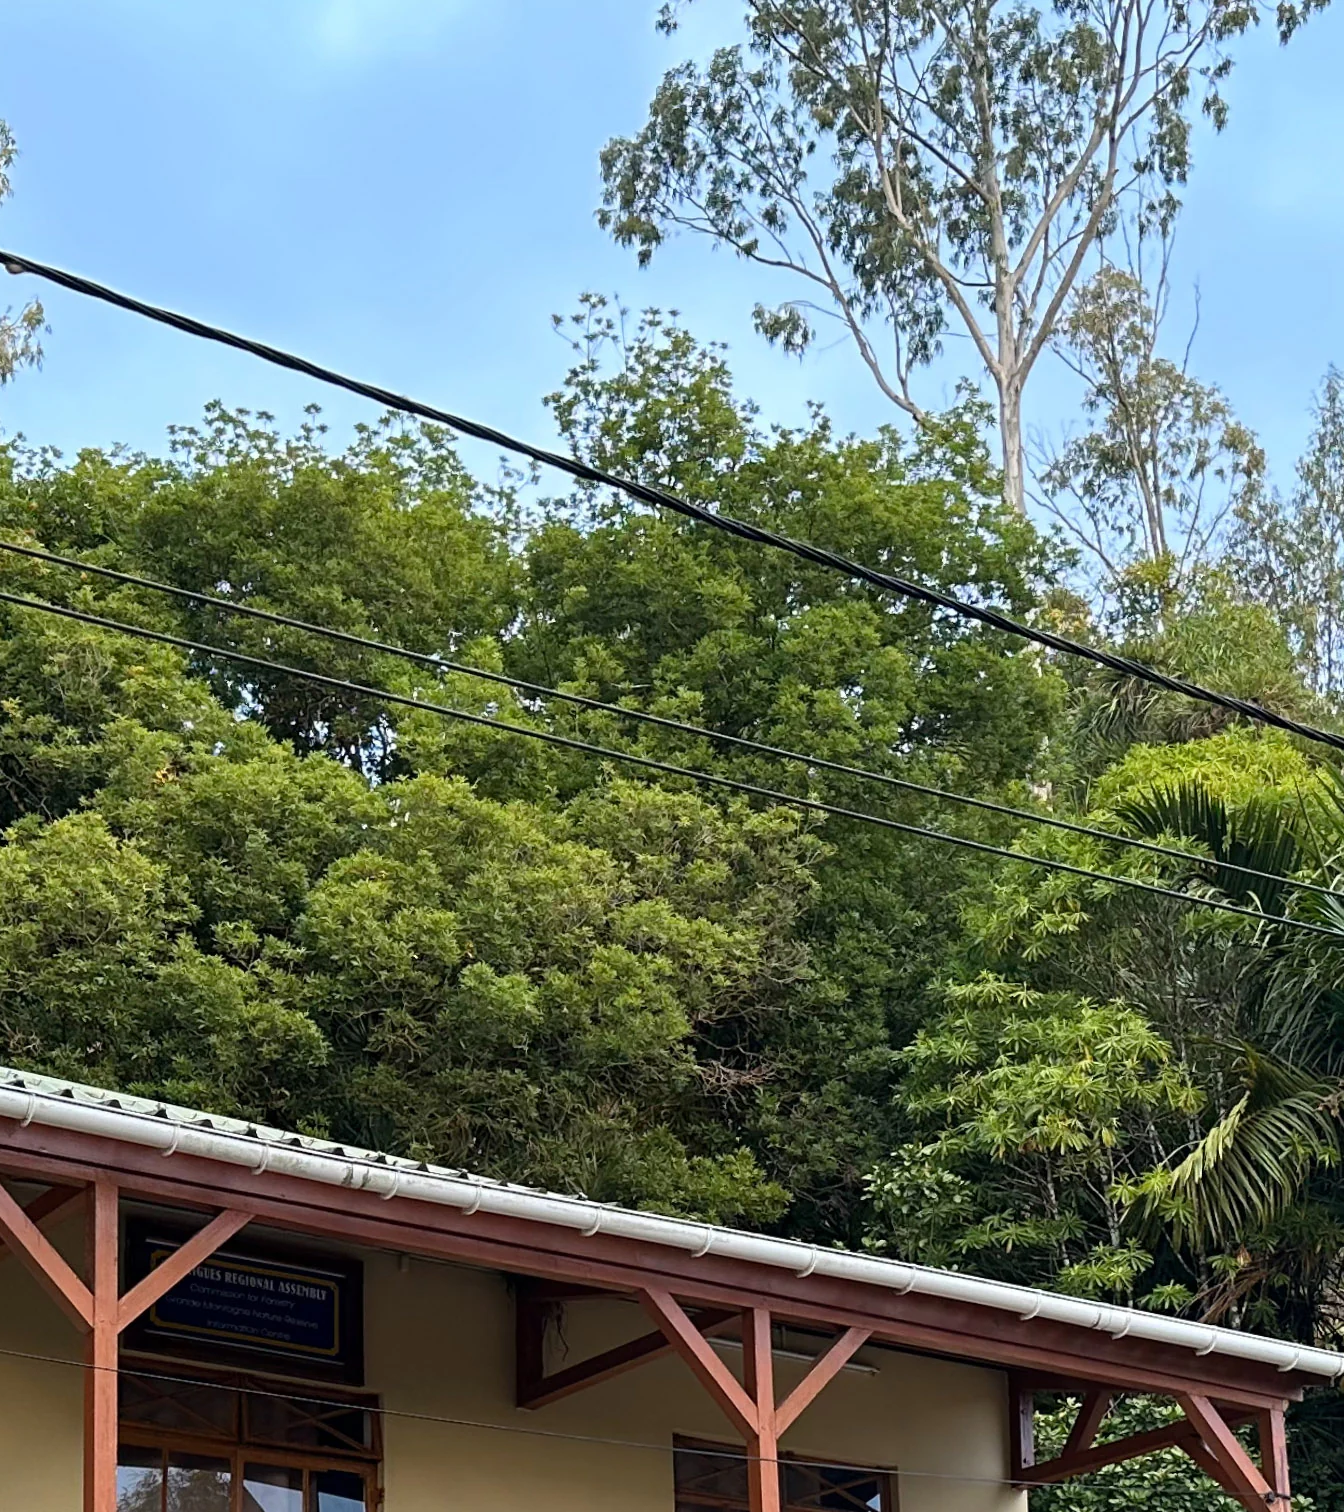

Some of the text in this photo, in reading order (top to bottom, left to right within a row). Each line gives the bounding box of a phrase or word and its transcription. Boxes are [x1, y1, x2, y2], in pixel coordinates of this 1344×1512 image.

[188, 1266, 328, 1301] IGUES REGIONAL ASSEMBLY
